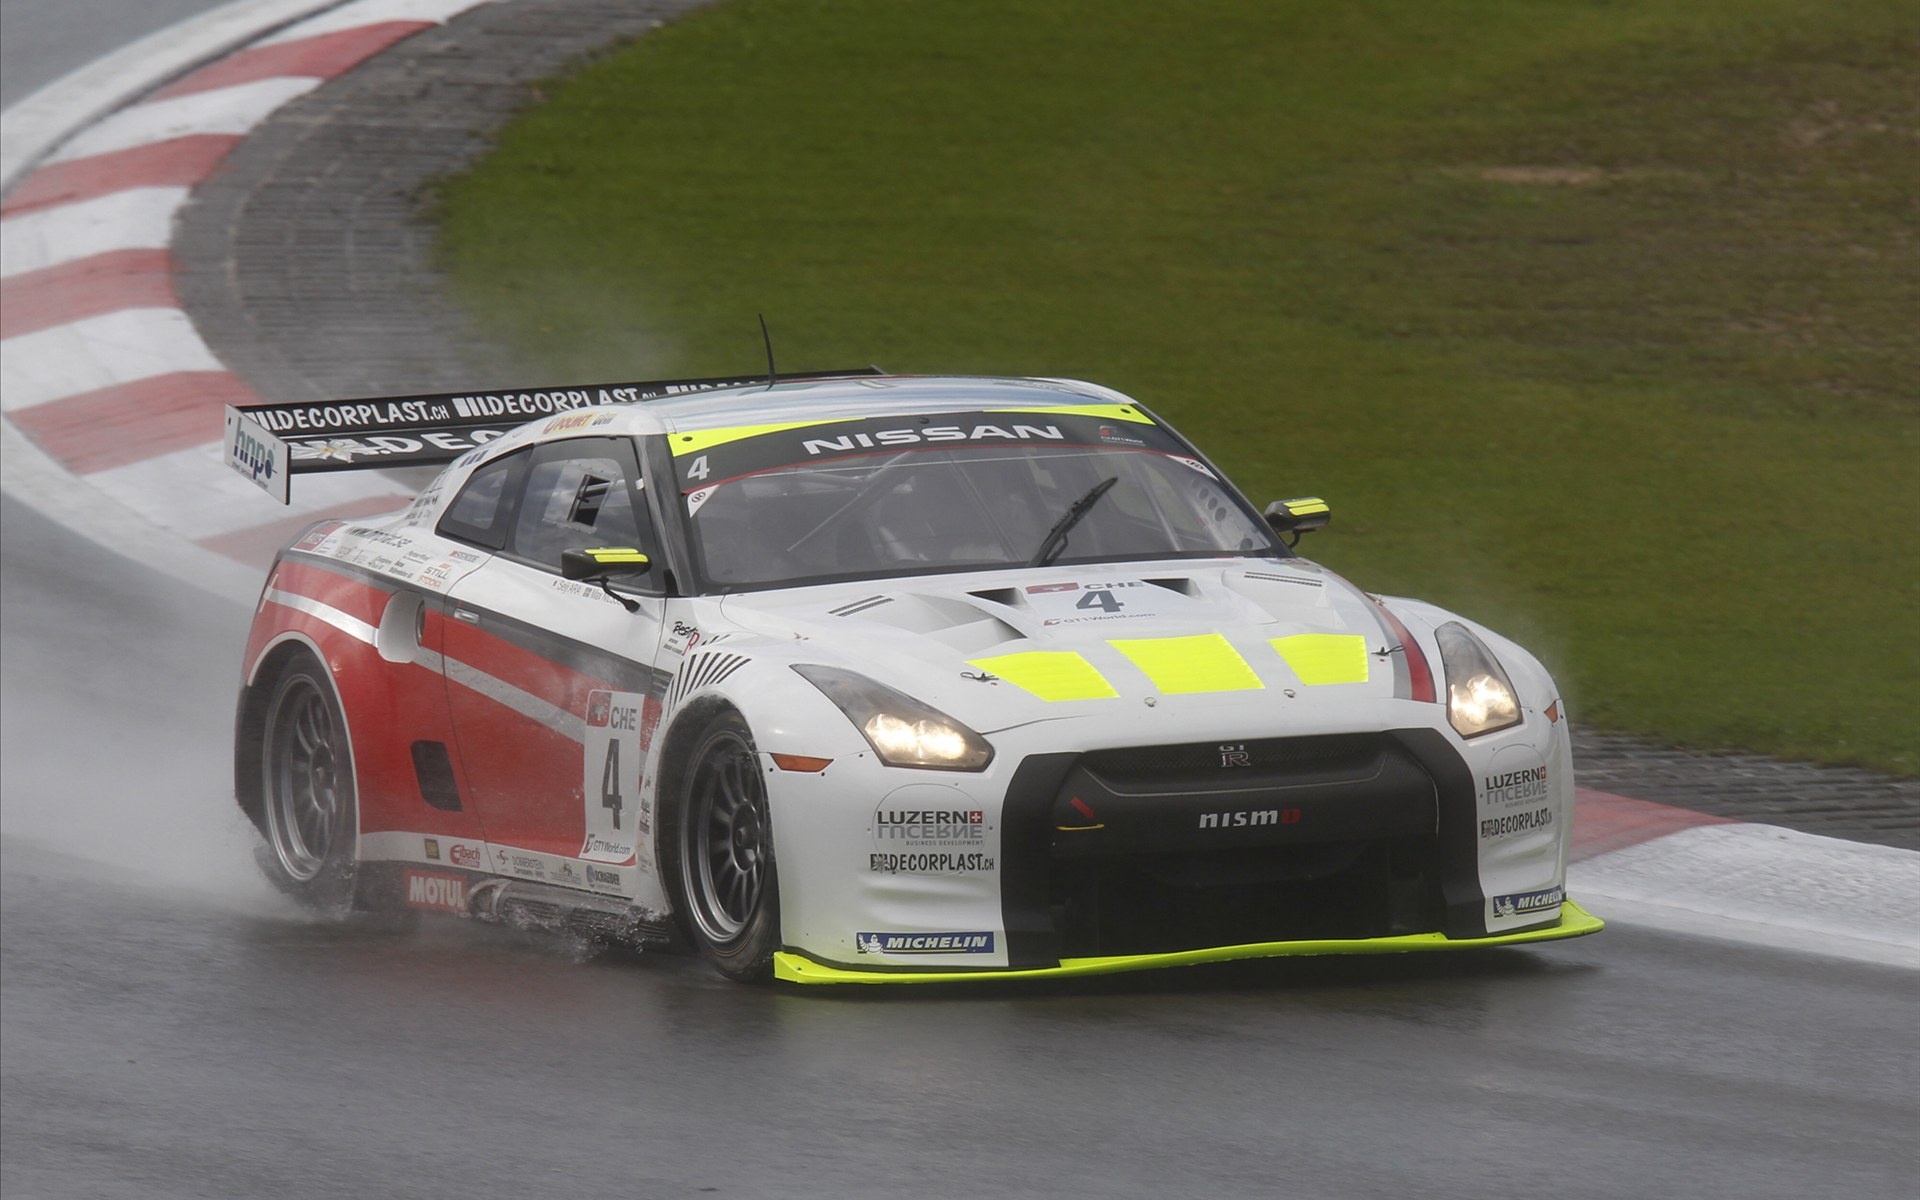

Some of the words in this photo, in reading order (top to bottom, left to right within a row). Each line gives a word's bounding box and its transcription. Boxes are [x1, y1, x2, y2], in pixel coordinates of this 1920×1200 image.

[802, 425, 1064, 455] NISSAN
[686, 455, 710, 480] 4
[1084, 581, 1145, 590] CHE
[1075, 590, 1124, 613] 4
[610, 706, 638, 731] CHE
[602, 738, 623, 831] 4
[1485, 767, 1540, 790] LUZERN
[878, 811, 968, 824] LUZERN
[409, 875, 466, 908] MOTUL
[886, 936, 988, 949] MICHELIN
